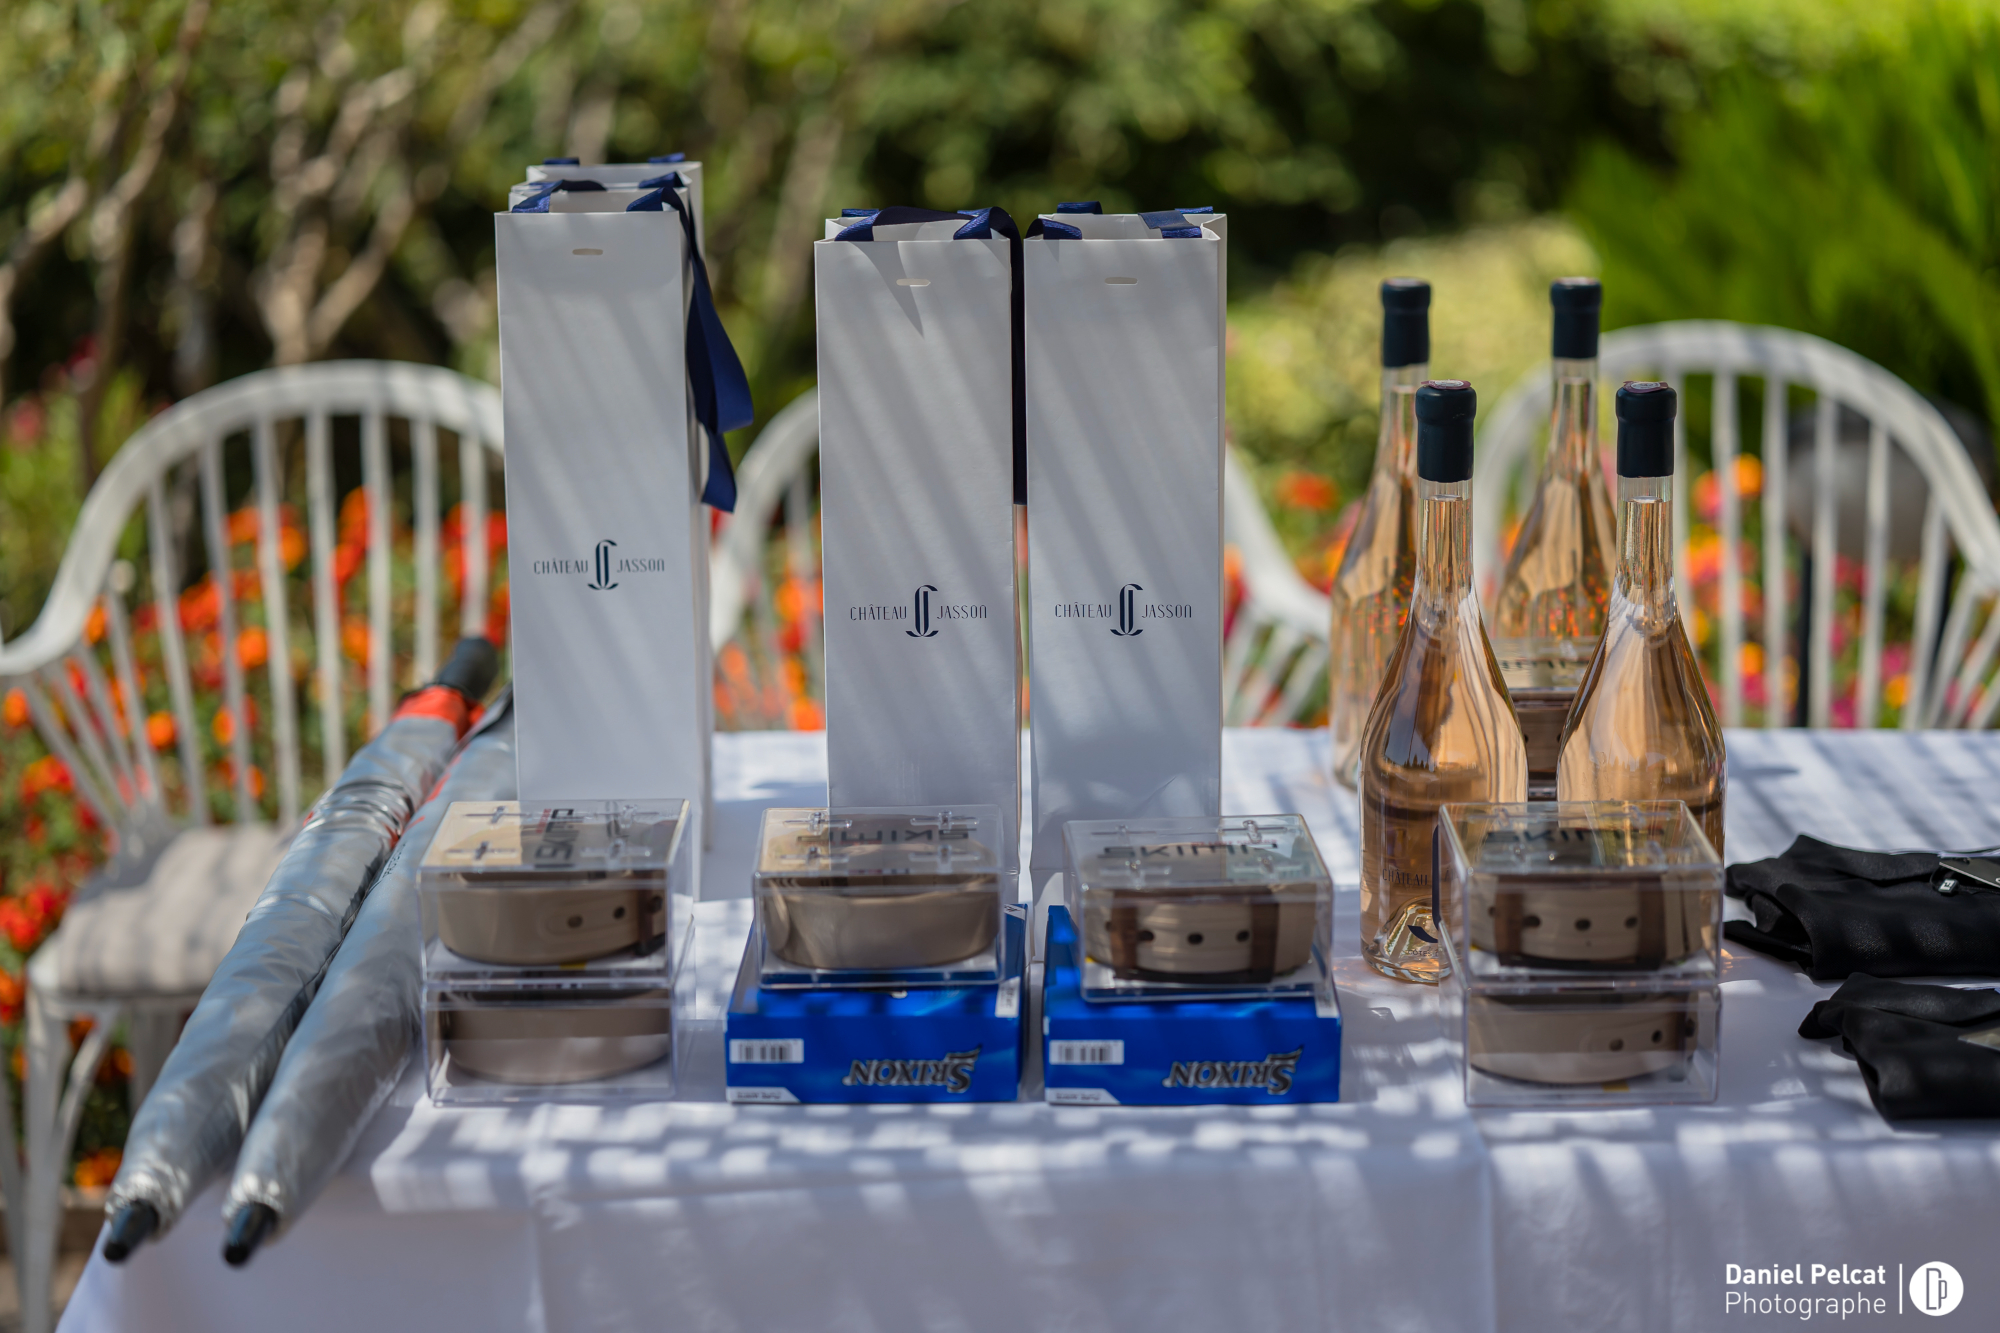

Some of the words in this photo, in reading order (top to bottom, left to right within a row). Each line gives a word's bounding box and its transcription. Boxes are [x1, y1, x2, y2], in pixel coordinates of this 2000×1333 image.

[533, 557, 589, 575] CHÂTEAU
[617, 558, 665, 573] JASSON
[850, 603, 907, 621] CHÂTEAU
[936, 604, 987, 619] JASSON
[1055, 601, 1112, 618] CHÂTEAU
[1141, 604, 1192, 618] JASSON
[1382, 868, 1428, 886] CHÂTEAU
[843, 1044, 982, 1093] SRIXON
[1162, 1044, 1304, 1094] SRIXON
